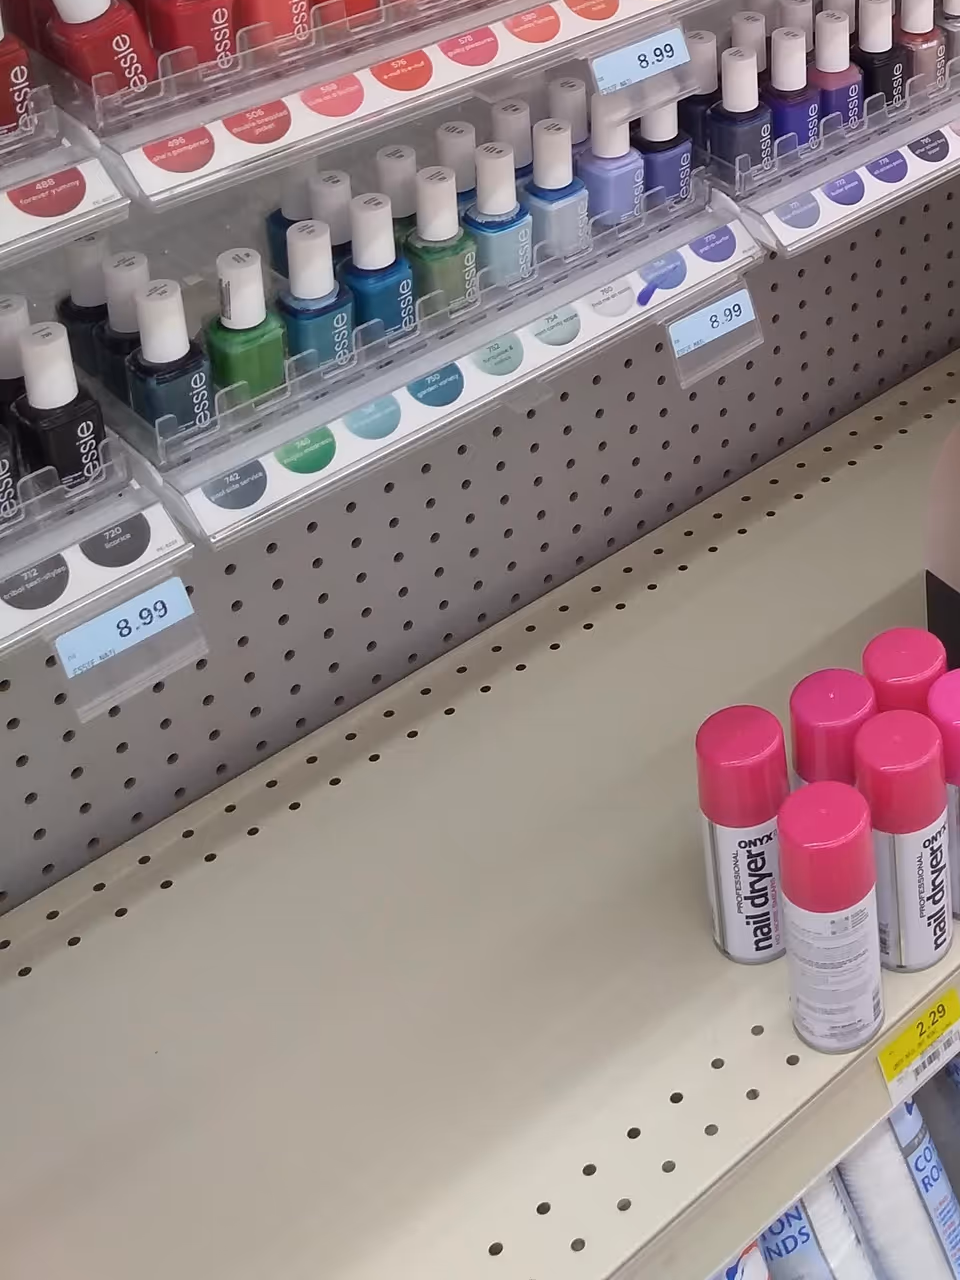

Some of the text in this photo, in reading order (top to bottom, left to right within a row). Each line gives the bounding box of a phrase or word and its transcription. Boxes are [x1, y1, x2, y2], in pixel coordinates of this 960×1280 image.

[211, 6, 233, 69] essie
[112, 33, 147, 93] essie
[391, 59, 407, 69] 576
[637, 43, 675, 70] 8.99
[10, 64, 34, 132] essie
[246, 108, 264, 119] 506
[167, 136, 186, 148] 496
[172, 138, 210, 157] pampered
[762, 121, 771, 170] essie
[35, 178, 55, 190] 488
[679, 151, 691, 201] essie
[19, 179, 80, 205] forever yummy
[401, 277, 413, 333] essie
[708, 301, 743, 330] 8.99
[545, 314, 559, 324] 754
[334, 312, 348, 368] essie
[487, 343, 500, 353] 752
[417, 374, 459, 398] garden variety
[425, 373, 441, 384] 750
[188, 371, 211, 428] essie
[74, 419, 102, 480] essie
[211, 471, 264, 501] pool side service
[224, 472, 241, 484] 742
[104, 526, 122, 540] 720
[104, 532, 132, 549] licorice
[21, 568, 39, 581] 712
[3, 586, 25, 600] tribal
[116, 598, 169, 639] 8.99
[738, 831, 774, 849] ONYX
[923, 825, 947, 849] ONYX
[733, 850, 744, 914] PROFESSIONAL
[916, 852, 927, 919] PROFESSIONAL
[743, 850, 773, 952] nail dryer
[926, 843, 948, 951] nail dryer
[916, 1003, 947, 1038] 2.29
